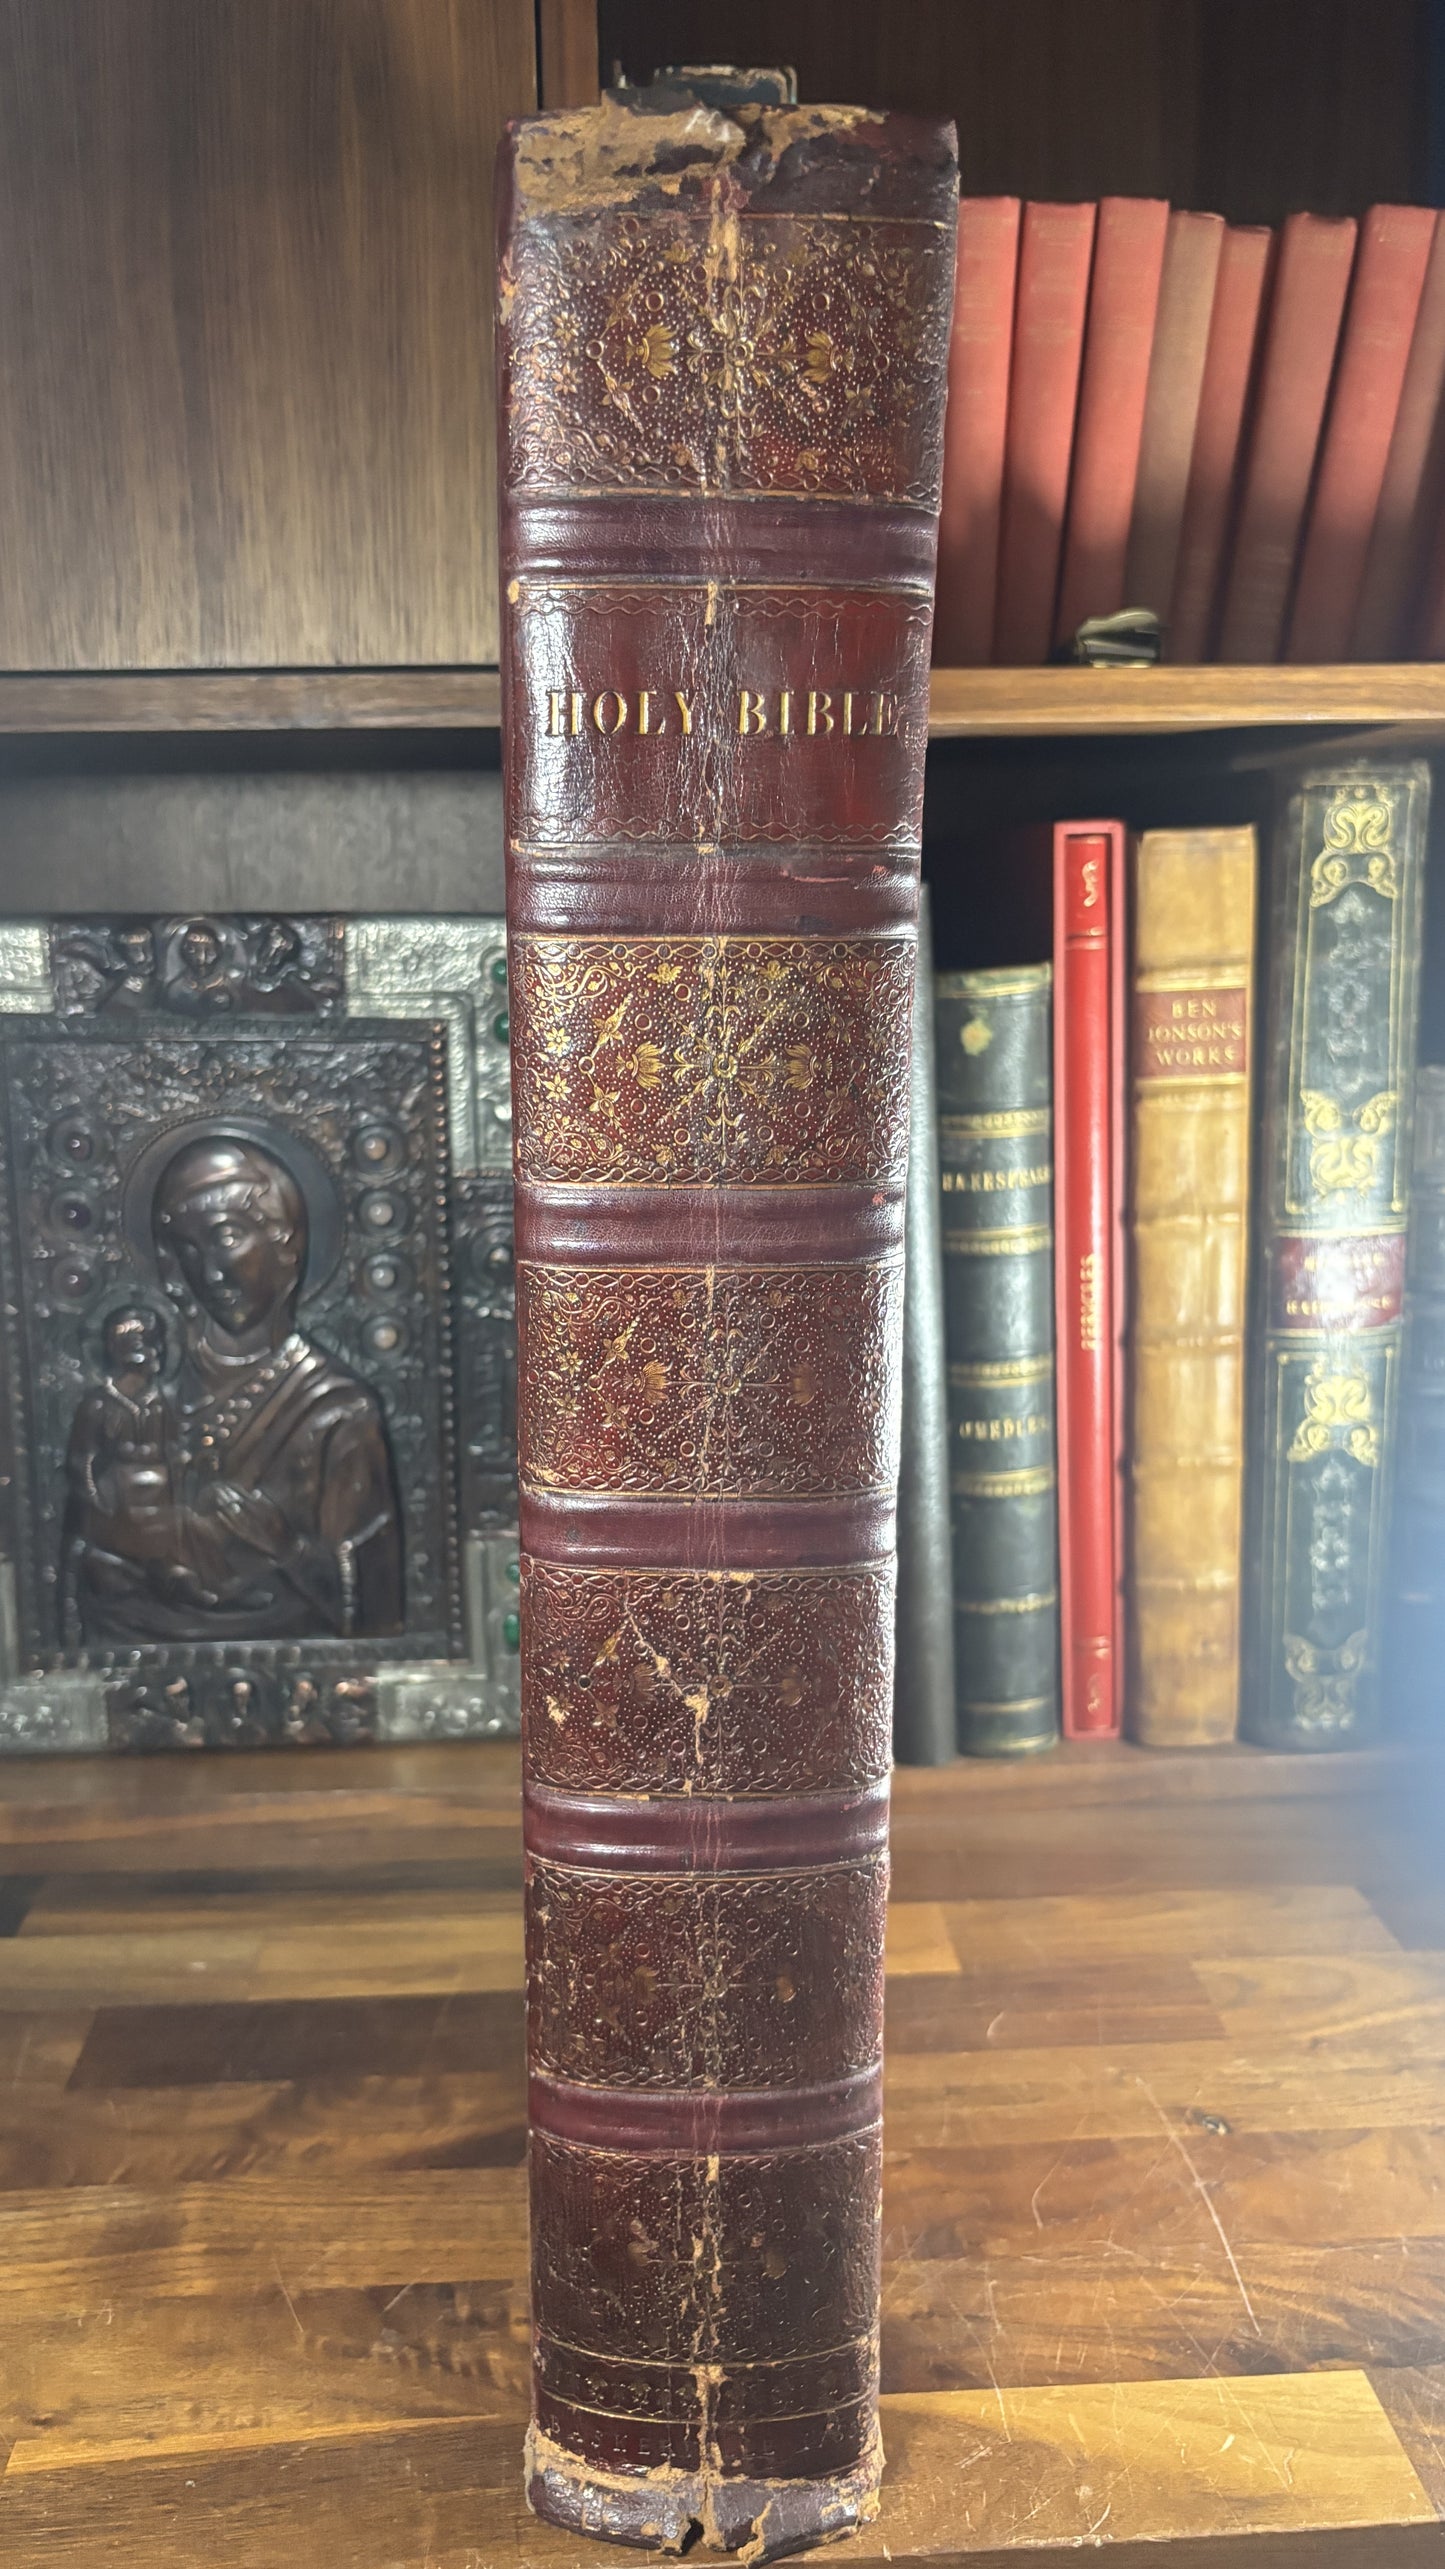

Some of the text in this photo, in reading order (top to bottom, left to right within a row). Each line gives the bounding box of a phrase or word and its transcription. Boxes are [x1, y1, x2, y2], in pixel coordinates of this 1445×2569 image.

[547, 690, 899, 736] HOLY BIBLE
[1171, 999, 1217, 1019] BEN
[1156, 1045, 1236, 1066] WORKS
